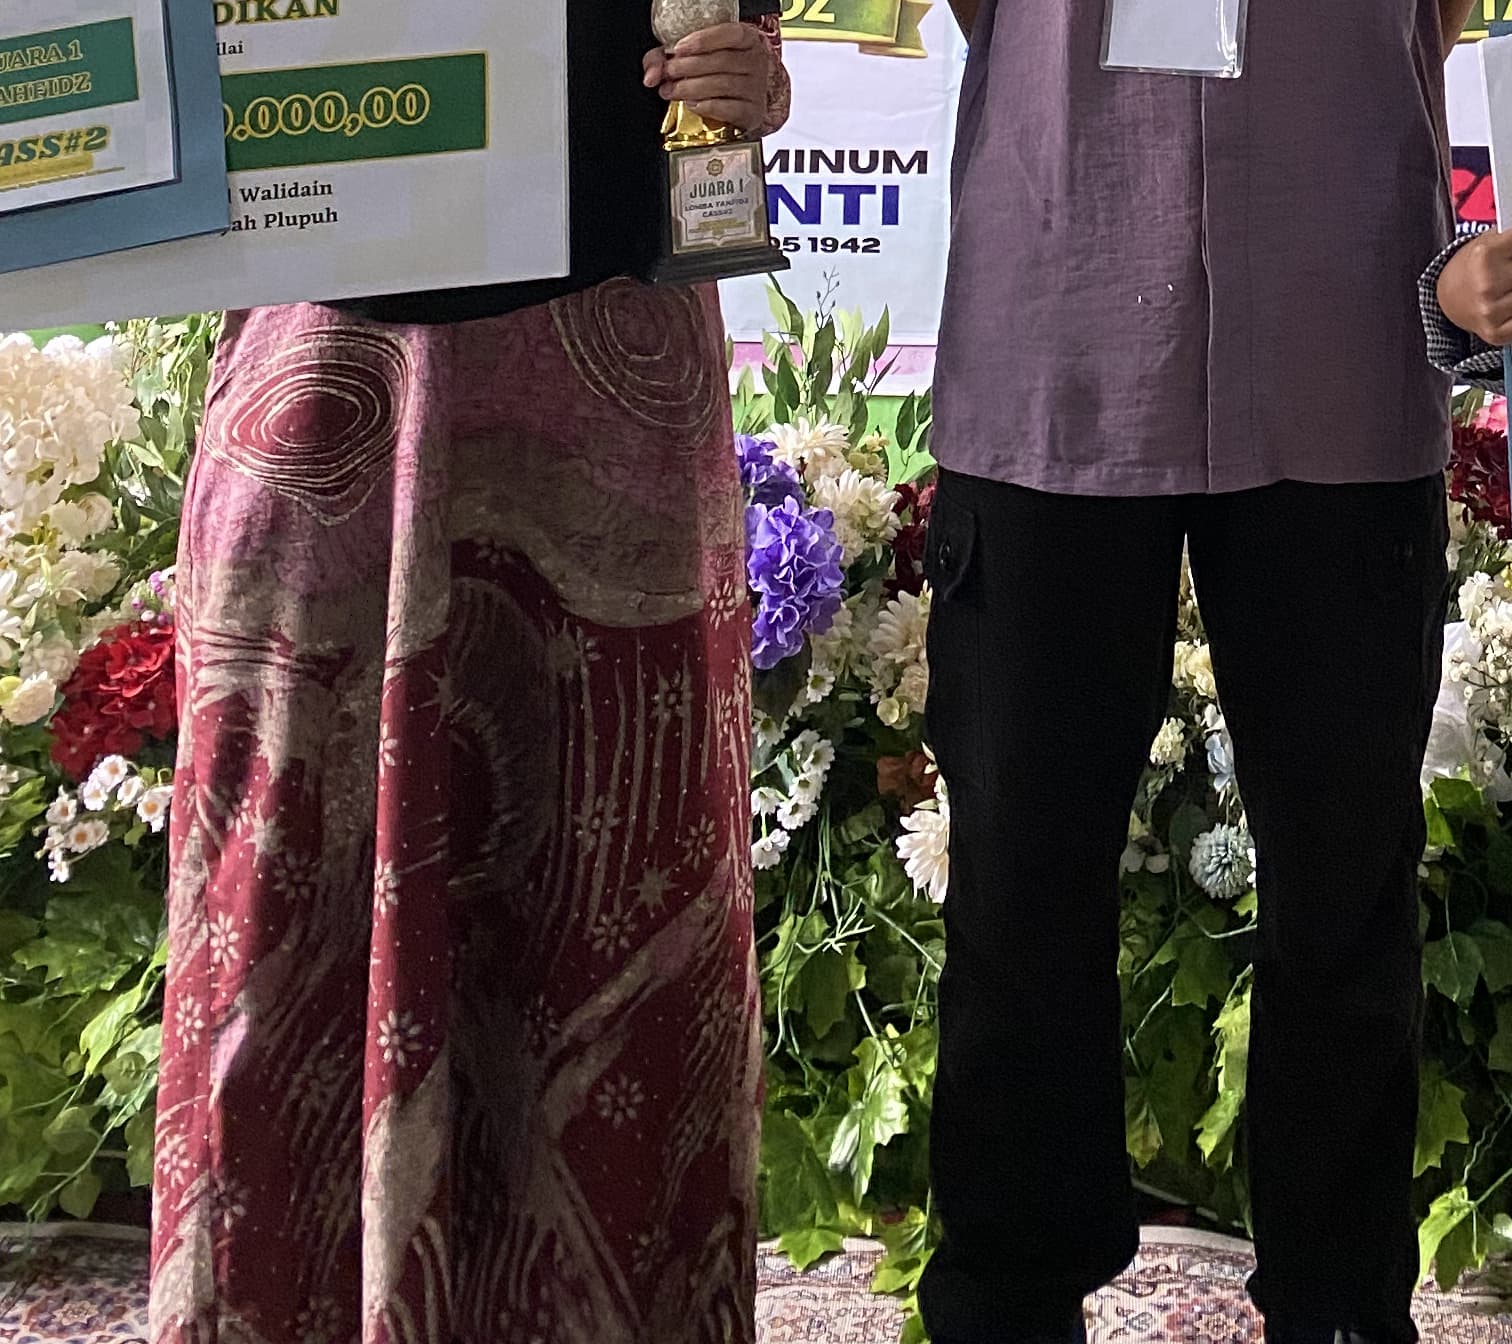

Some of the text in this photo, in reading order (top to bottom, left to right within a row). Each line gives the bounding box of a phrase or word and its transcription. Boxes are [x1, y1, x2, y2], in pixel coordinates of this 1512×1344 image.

[68, 39, 84, 61] 1
[222, 83, 430, 142] .000,00
[240, 180, 334, 203] Walidain
[689, 179, 735, 199] JUARA
[264, 207, 339, 230] Plupuh
[808, 237, 881, 254] 1942
